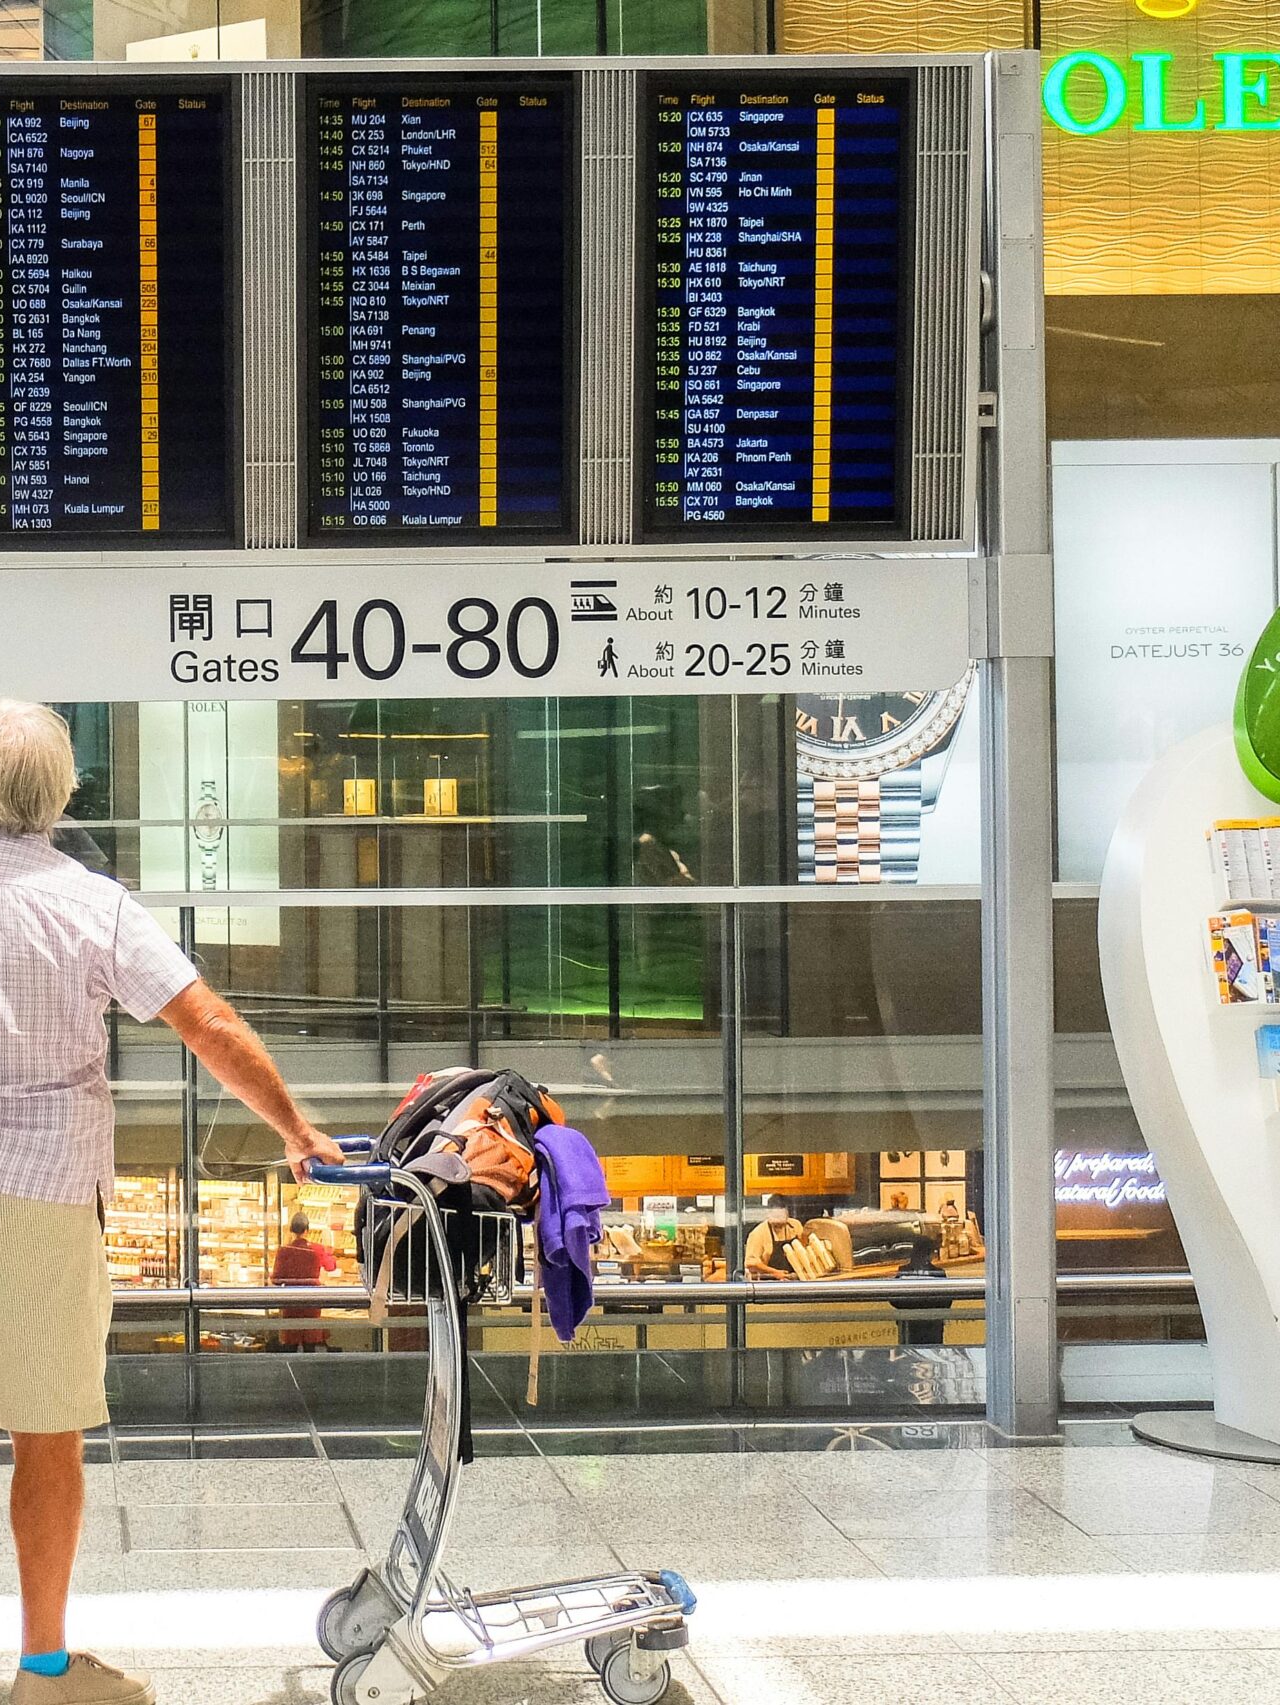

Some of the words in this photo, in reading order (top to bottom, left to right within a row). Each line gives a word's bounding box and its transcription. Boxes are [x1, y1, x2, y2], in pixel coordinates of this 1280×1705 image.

[9, 118, 23, 127] KA
[25, 118, 41, 127] 992
[60, 117, 89, 129] Beijing
[320, 115, 343, 125] 14:35
[352, 115, 367, 124] MU
[370, 115, 385, 124] 204
[402, 115, 421, 124] Xian
[320, 131, 343, 140] 14:40
[352, 130, 365, 140] CX
[368, 130, 384, 140] 253
[402, 129, 455, 139] London/LHR
[659, 173, 681, 182] 15:20
[690, 172, 703, 182] SC
[705, 172, 727, 182] 4790
[739, 172, 762, 181] Jinan
[658, 188, 681, 197] 15:20
[689, 188, 703, 197] VN
[706, 187, 722, 197] 595
[739, 187, 751, 196] Ho
[754, 187, 768, 196] Chi
[771, 187, 791, 196] Minh
[321, 222, 343, 231] 14:50
[352, 221, 365, 230] CX
[370, 221, 383, 230] 171
[402, 221, 425, 230] Perth
[658, 322, 680, 331] 15:35
[689, 322, 701, 331] FD
[704, 322, 719, 331] 521
[738, 322, 760, 331] Krabi
[13, 344, 26, 353] HX
[29, 343, 45, 353] 272
[63, 344, 106, 354] Nanchang
[13, 358, 27, 367] CX
[30, 358, 50, 367] 7680
[63, 358, 89, 367] Dallas
[92, 357, 131, 366] FT.Worth
[657, 366, 679, 375] 15:40
[688, 366, 698, 375] 5J
[701, 366, 717, 375] 237
[737, 365, 760, 374] Cebu
[322, 516, 344, 525] 15:15
[354, 516, 367, 525] OD
[370, 516, 386, 524] 606
[403, 515, 427, 524] Kuala
[430, 516, 462, 525] Lumpur
[655, 585, 672, 604] 約
[800, 582, 844, 602] 分鐘
[626, 608, 672, 620] About
[687, 586, 786, 619] 10-12
[800, 606, 860, 618] Minutes
[170, 595, 272, 642] 閘口
[1125, 627, 1165, 635] OYSTER
[1169, 626, 1229, 634] PERPETUAL
[171, 651, 279, 683] Gates
[291, 597, 559, 680] 40-80
[656, 641, 673, 661] 約
[801, 639, 845, 659] 分鐘
[1111, 644, 1212, 658] DATEJUST
[1218, 643, 1244, 657] 36
[628, 665, 673, 677] About
[685, 644, 790, 676] 20-25
[802, 663, 862, 675] Minutes
